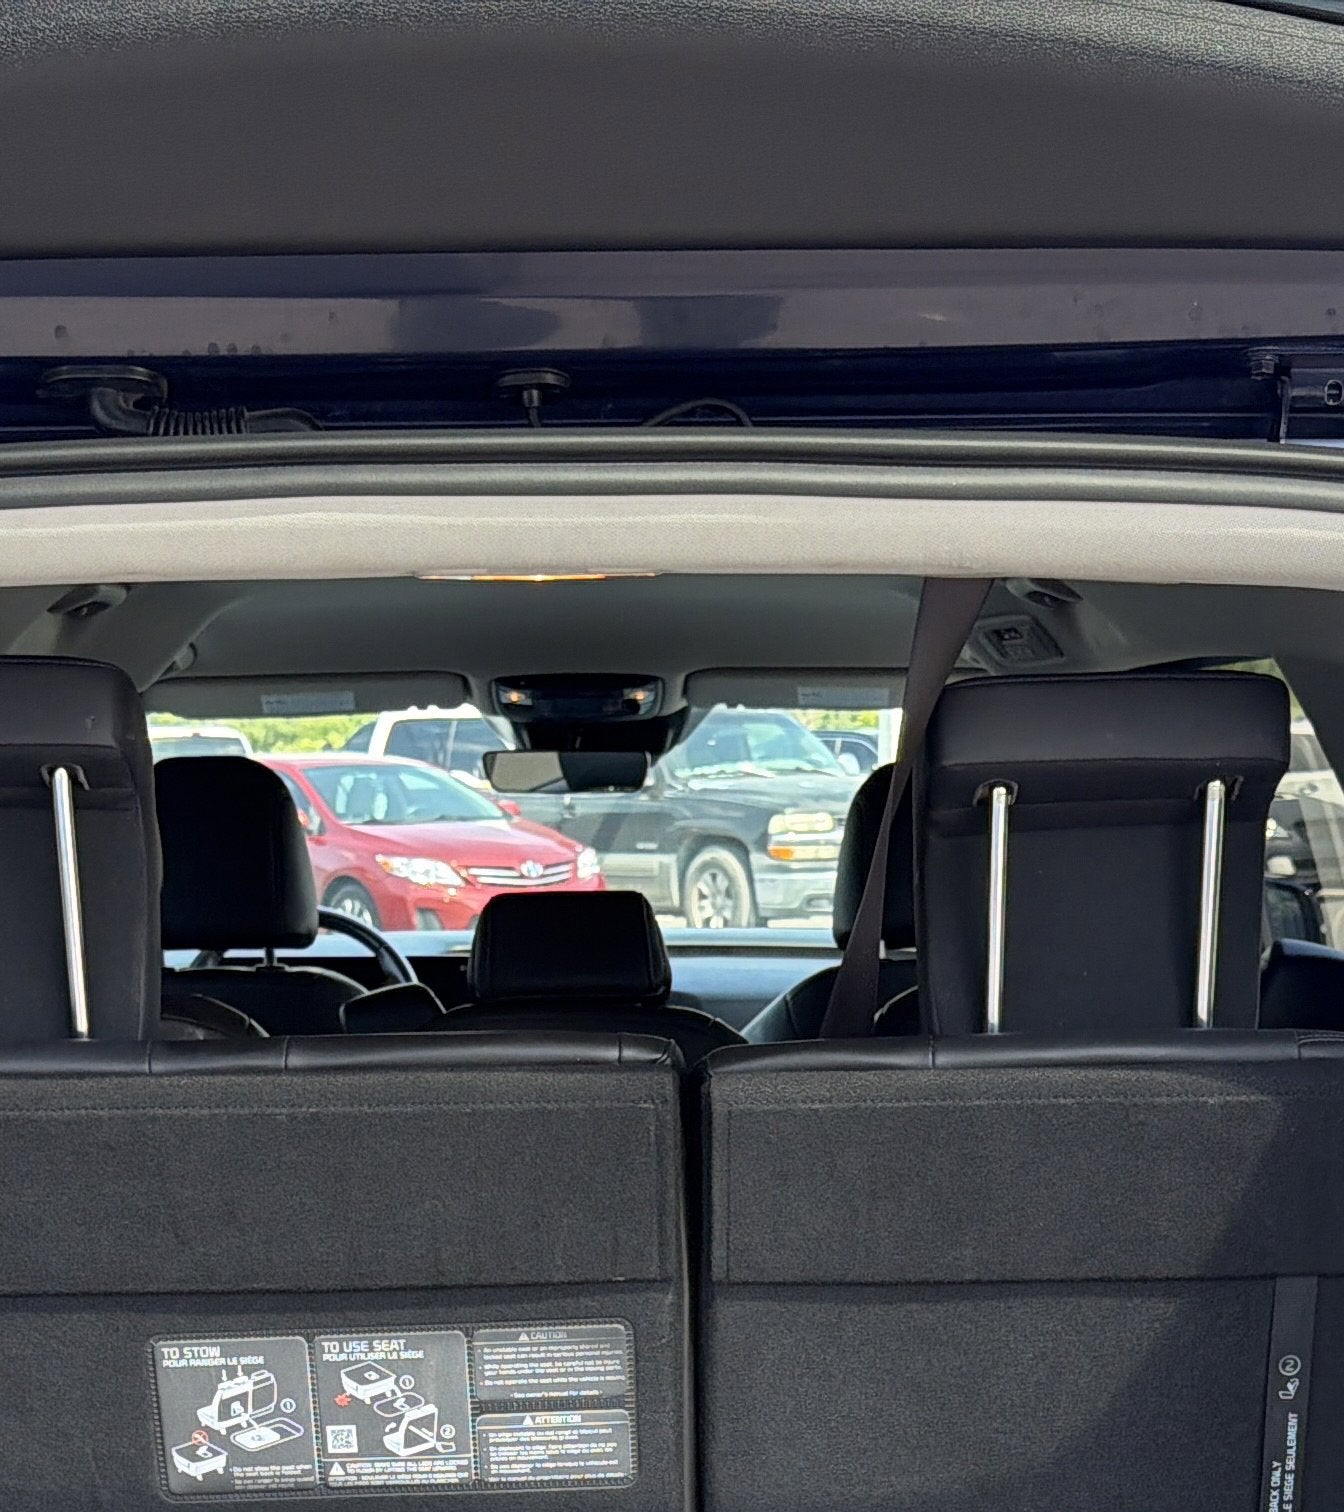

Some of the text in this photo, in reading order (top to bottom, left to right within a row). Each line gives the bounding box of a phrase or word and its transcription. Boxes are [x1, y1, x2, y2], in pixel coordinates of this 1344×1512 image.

[530, 1331, 567, 1340] CAUTION
[161, 1345, 221, 1359] TO STOW
[321, 1339, 406, 1353] TO USE SEAT
[162, 1358, 189, 1368] POUR
[189, 1357, 226, 1367] RANGER
[227, 1356, 239, 1366] LE
[322, 1352, 348, 1362] POUR
[348, 1351, 386, 1361] UTILISER
[387, 1351, 398, 1360] LE
[534, 1414, 582, 1424] ATTENTION
[1285, 1411, 1299, 1471] SEULEMENT
[1271, 1460, 1282, 1488] ONLY
[1282, 1473, 1295, 1502] SIEGE
